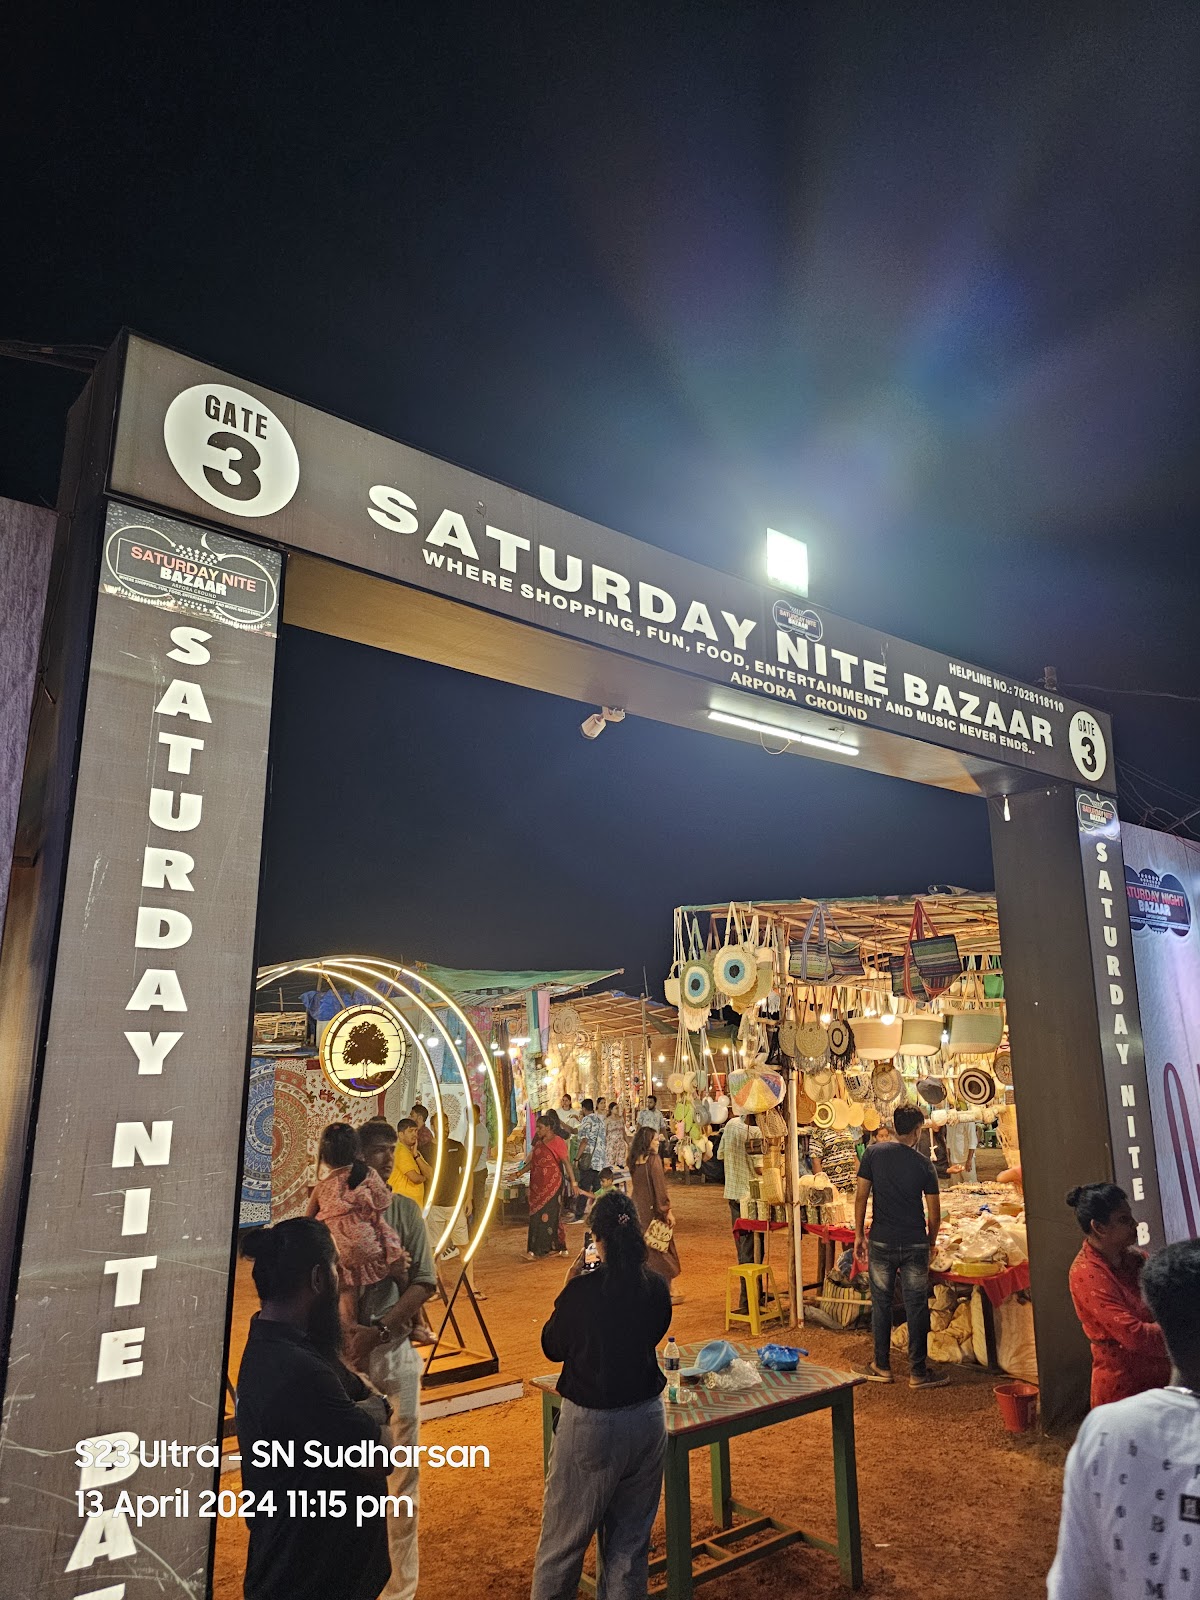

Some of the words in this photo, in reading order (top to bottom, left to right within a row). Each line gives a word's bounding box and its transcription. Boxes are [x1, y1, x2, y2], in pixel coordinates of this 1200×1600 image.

[205, 394, 268, 440] GATE
[203, 431, 262, 501] 3
[131, 546, 219, 580] SATURDAY
[222, 572, 257, 593] NITE
[160, 566, 227, 596] BAZAAR
[367, 484, 757, 650] SATURDAY
[776, 629, 889, 696] NITE
[903, 672, 1054, 748] BAZAAR
[422, 548, 513, 593] WHERE
[520, 583, 641, 637] SHOPPING,
[647, 625, 691, 653] FUN,
[696, 642, 750, 671] FOOD,
[754, 660, 882, 709] ENTERTAINMENT
[886, 701, 914, 719] AND
[916, 709, 957, 732] MUSIC
[959, 722, 998, 744] NEVER
[1000, 735, 1036, 755] ENDS..
[730, 671, 797, 701] ARPORA
[805, 694, 868, 721] GROUND
[949, 662, 993, 688] HELPLINE
[993, 677, 1013, 695] NO.:
[1013, 685, 1064, 713] 7028118110
[1077, 717, 1096, 737] GATE
[1081, 737, 1097, 773] 3
[124, 626, 213, 1075] SATURDAY
[1125, 885, 1160, 902] ATURDAY
[1160, 892, 1184, 907] NIGHT
[1138, 899, 1171, 917] BAZAAR
[1096, 842, 1129, 1065] SATURDAY
[1121, 1084, 1145, 1201] NITE
[97, 1120, 174, 1383] NITE
[64, 1431, 140, 1600] BA
